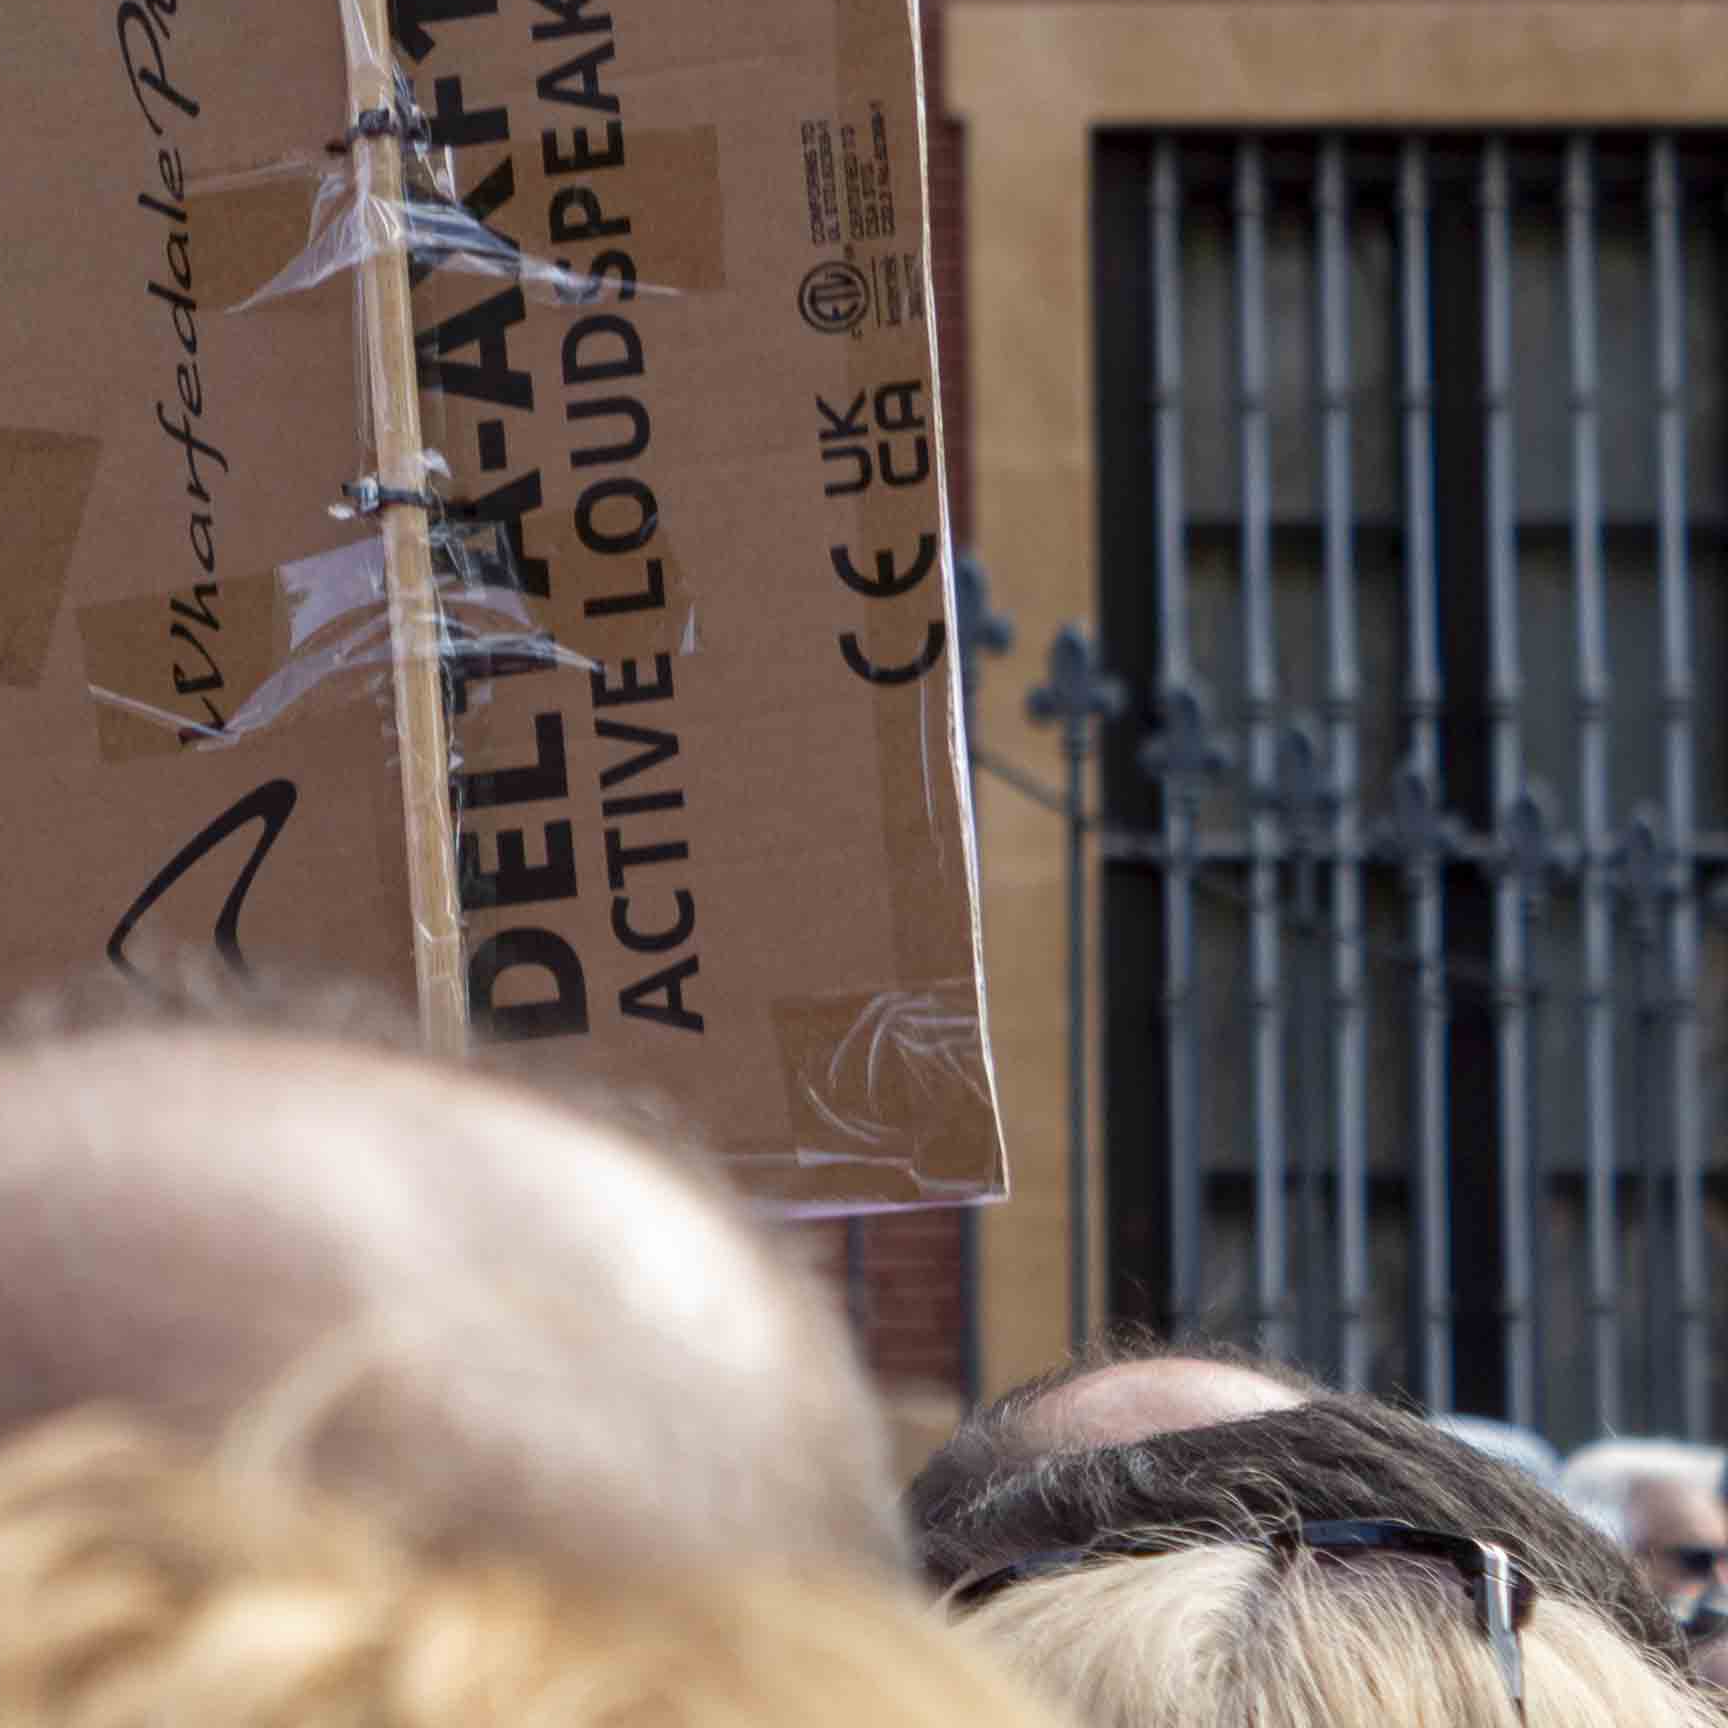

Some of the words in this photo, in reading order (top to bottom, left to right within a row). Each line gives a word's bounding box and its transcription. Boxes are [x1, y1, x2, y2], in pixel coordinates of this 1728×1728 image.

[138, 146, 228, 746] Wharfedale
[815, 387, 873, 498] UK
[873, 379, 930, 487] CA
[829, 532, 945, 688] CE
[590, 652, 705, 1034] ACTIVE
